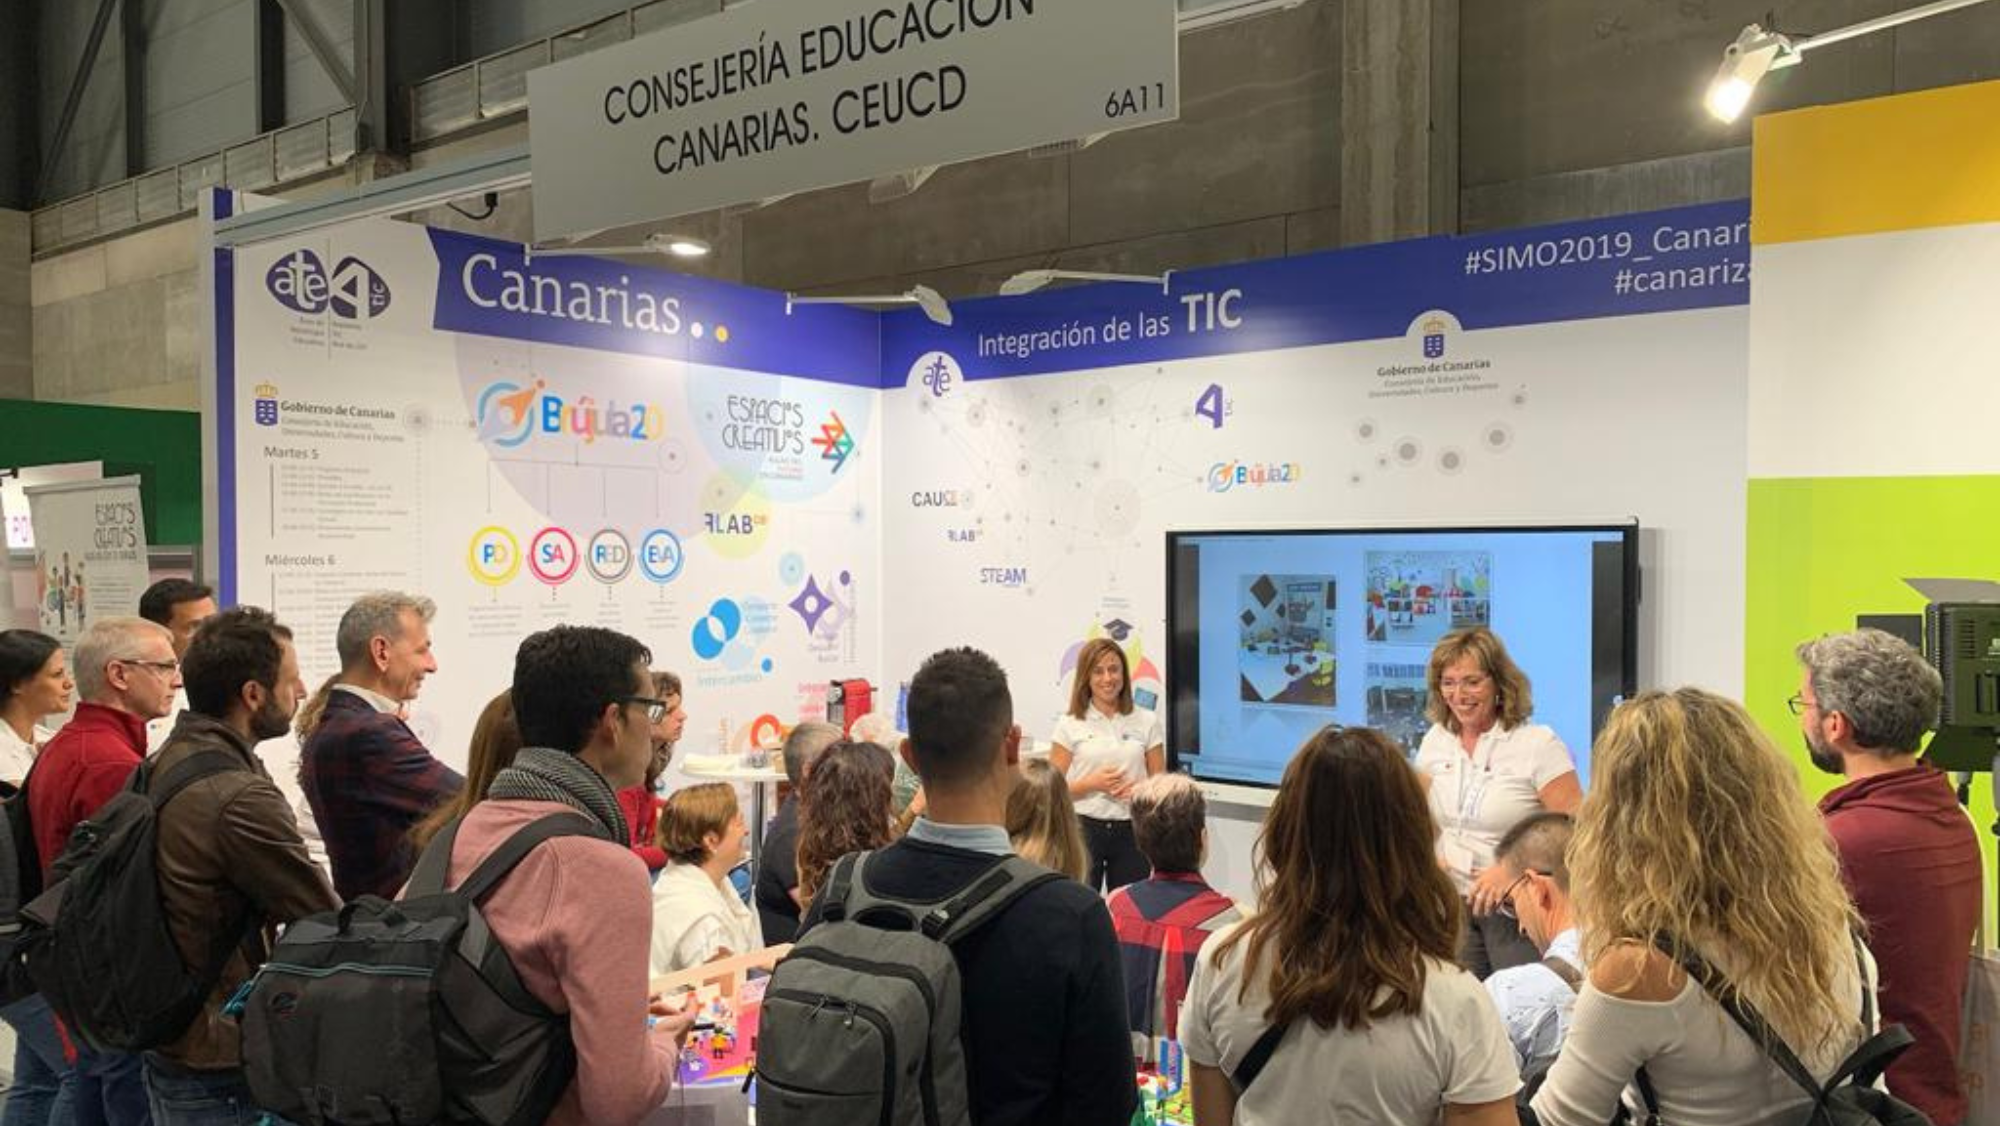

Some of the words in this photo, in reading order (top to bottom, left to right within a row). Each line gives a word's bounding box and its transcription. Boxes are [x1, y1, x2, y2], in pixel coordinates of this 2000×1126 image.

[604, 31, 789, 125] CONSEJERÍA
[1105, 82, 1165, 119] 6A11
[653, 102, 819, 175] CANARIAS.
[832, 64, 967, 134] CEUCD
[1465, 220, 1748, 274] #SIMO2019_Canar
[1615, 257, 1750, 295] #canariz
[979, 320, 1096, 358] Integración
[1103, 317, 1131, 343] de
[1139, 312, 1170, 338] las
[1181, 288, 1243, 333] TIC
[1377, 364, 1426, 377] Gobierno
[1428, 362, 1441, 372] de
[1443, 360, 1491, 372] Canarias
[281, 400, 333, 415] Gobierno
[335, 404, 348, 416] de
[349, 405, 395, 419] Canarias
[264, 447, 308, 459] Martes
[312, 448, 319, 460] 5
[265, 554, 326, 567] Miércoles
[542, 543, 565, 564] SA
[981, 567, 1027, 584] STEAM
